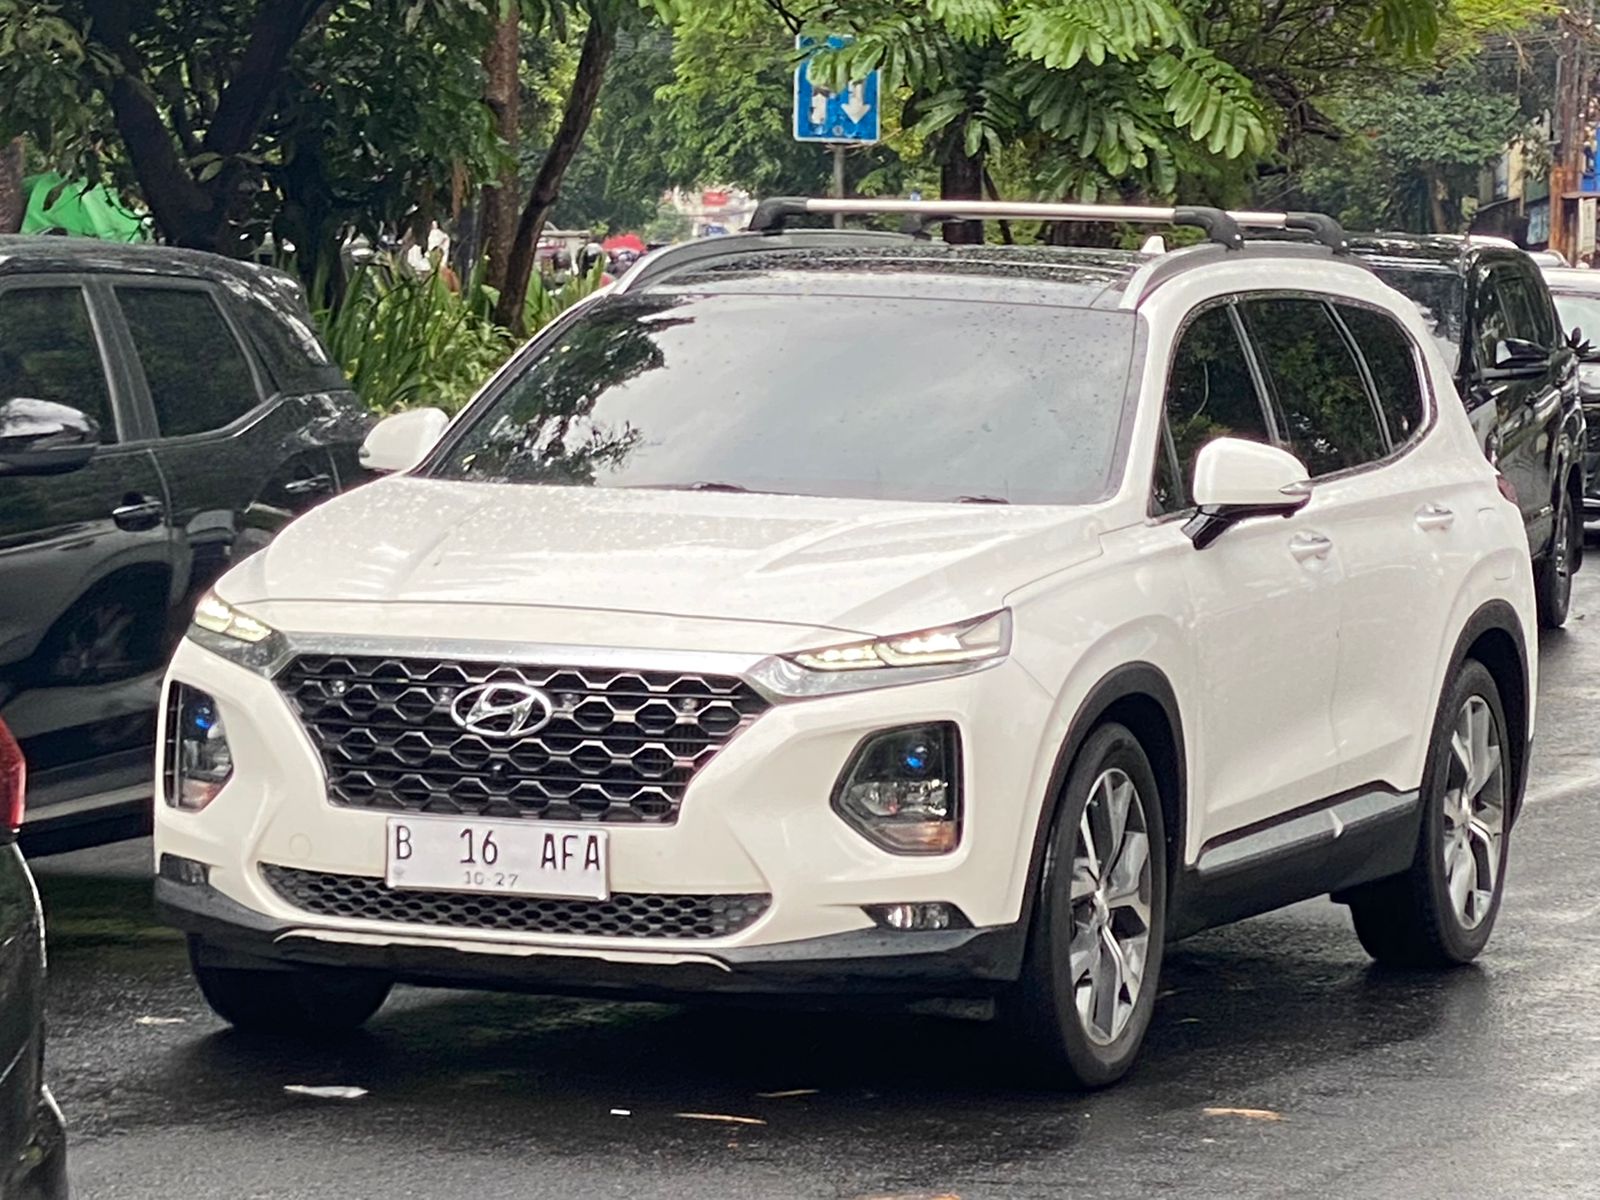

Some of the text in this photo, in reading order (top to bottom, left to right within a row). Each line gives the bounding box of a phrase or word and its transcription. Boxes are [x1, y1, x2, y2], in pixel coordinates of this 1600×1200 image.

[396, 825, 600, 871] B 16 AFA
